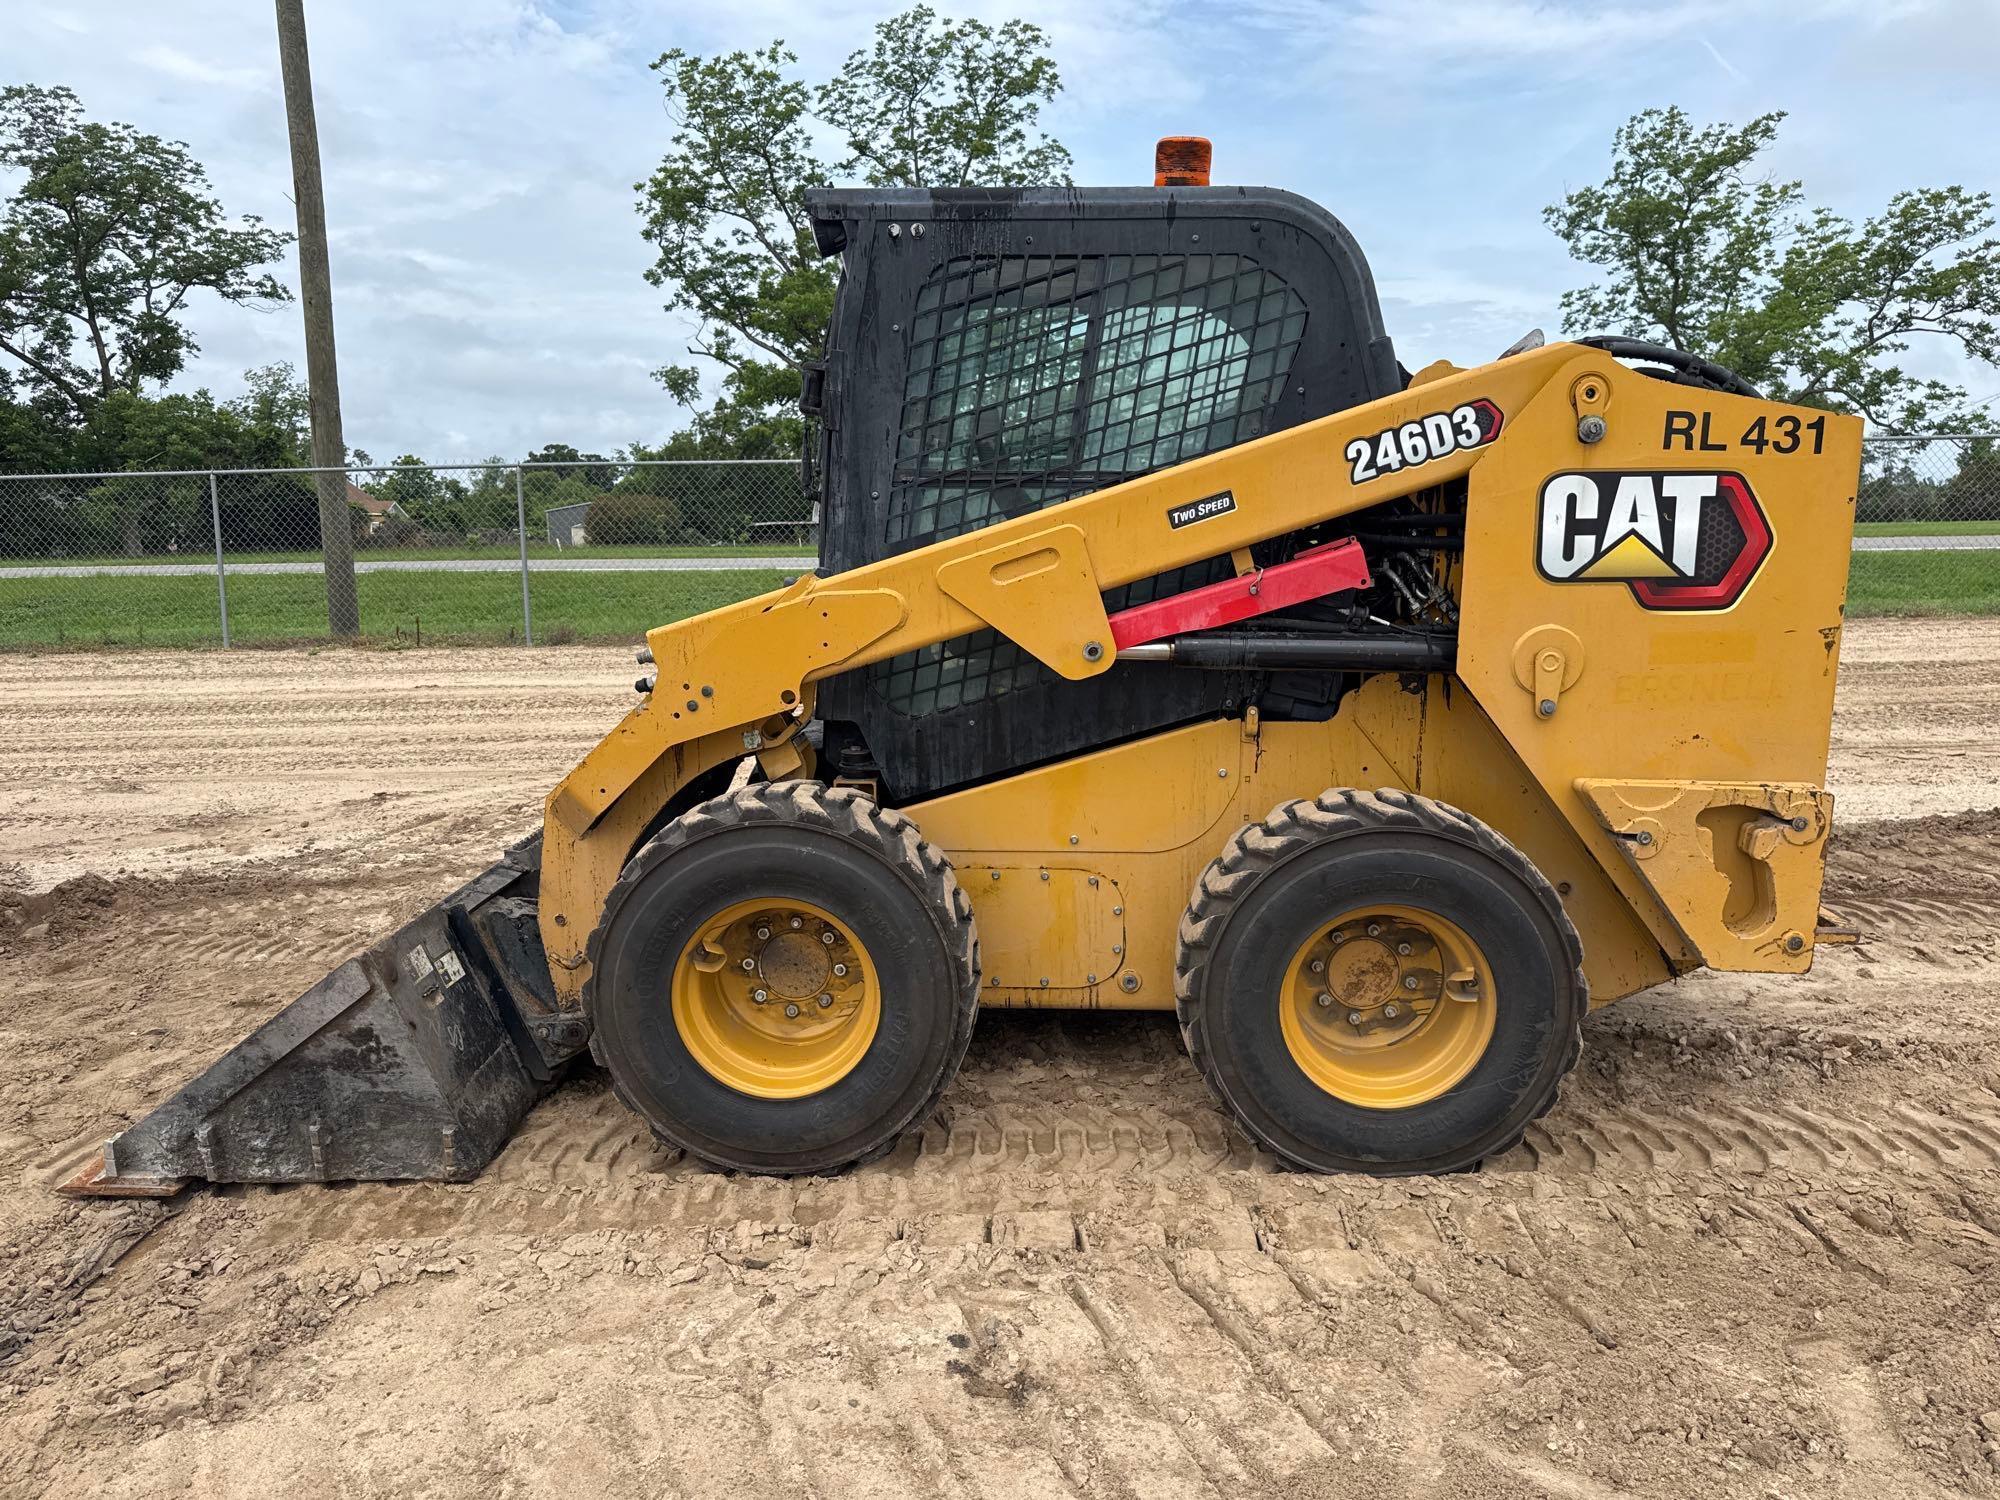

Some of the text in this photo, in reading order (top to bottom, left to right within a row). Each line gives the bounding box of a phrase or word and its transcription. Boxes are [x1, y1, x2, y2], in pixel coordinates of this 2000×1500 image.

[1347, 405, 1482, 482] 246D3
[1663, 411, 1827, 455] RL 431
[1173, 497, 1230, 524] TWO SPEED
[1541, 475, 1719, 578] CAT
